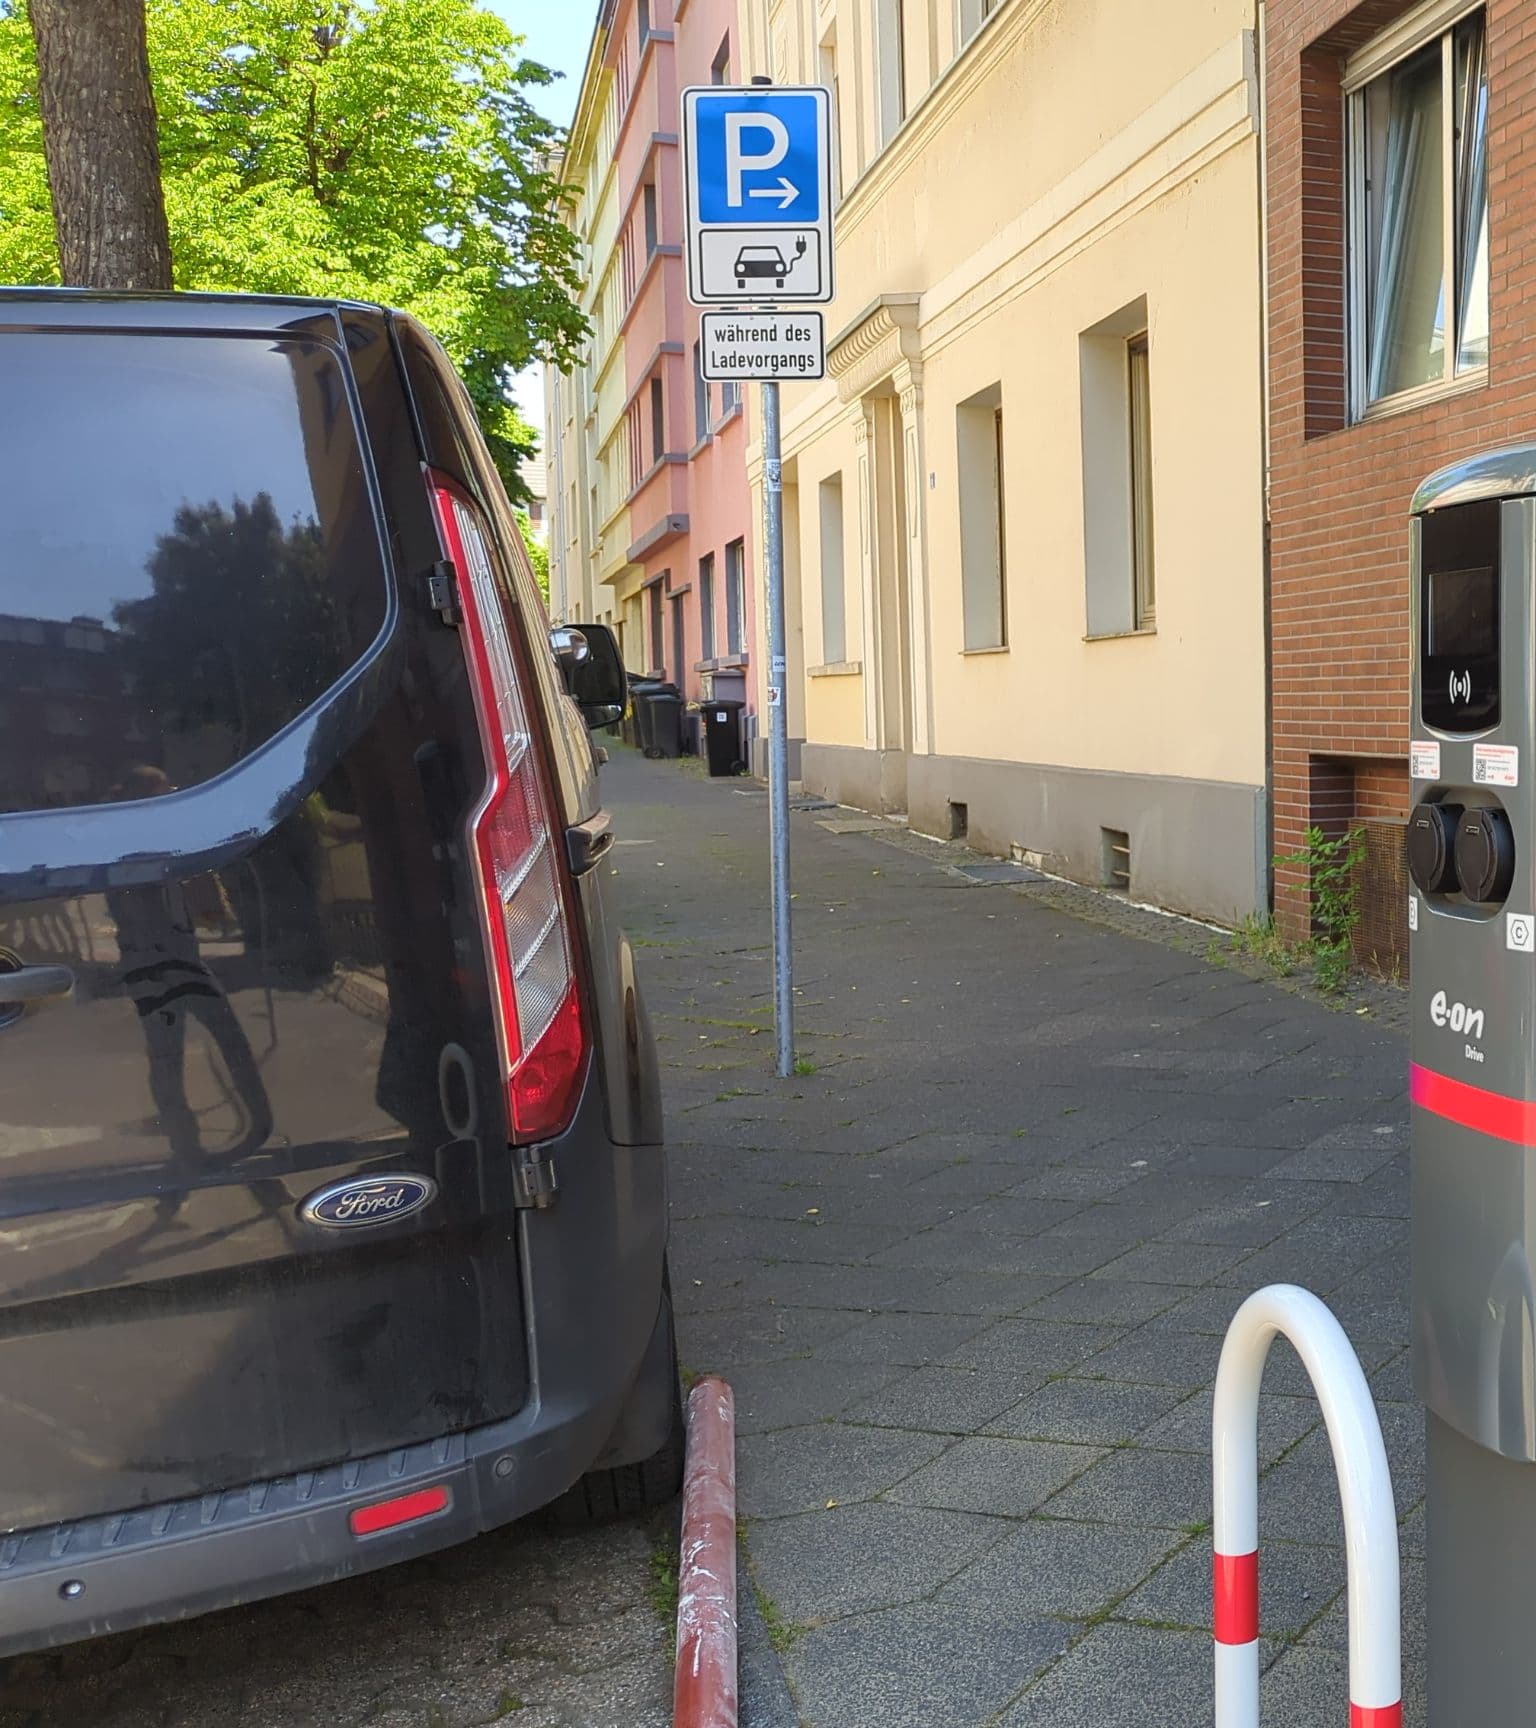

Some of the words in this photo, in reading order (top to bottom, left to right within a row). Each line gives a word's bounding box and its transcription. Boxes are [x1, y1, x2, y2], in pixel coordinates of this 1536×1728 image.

[725, 112, 789, 208] P
[714, 324, 777, 342] während
[785, 324, 811, 342] des
[712, 350, 815, 373] Ladevorgangs
[1515, 927, 1523, 939] C
[1465, 1044, 1485, 1063] Drive
[335, 1185, 405, 1219] Ford
